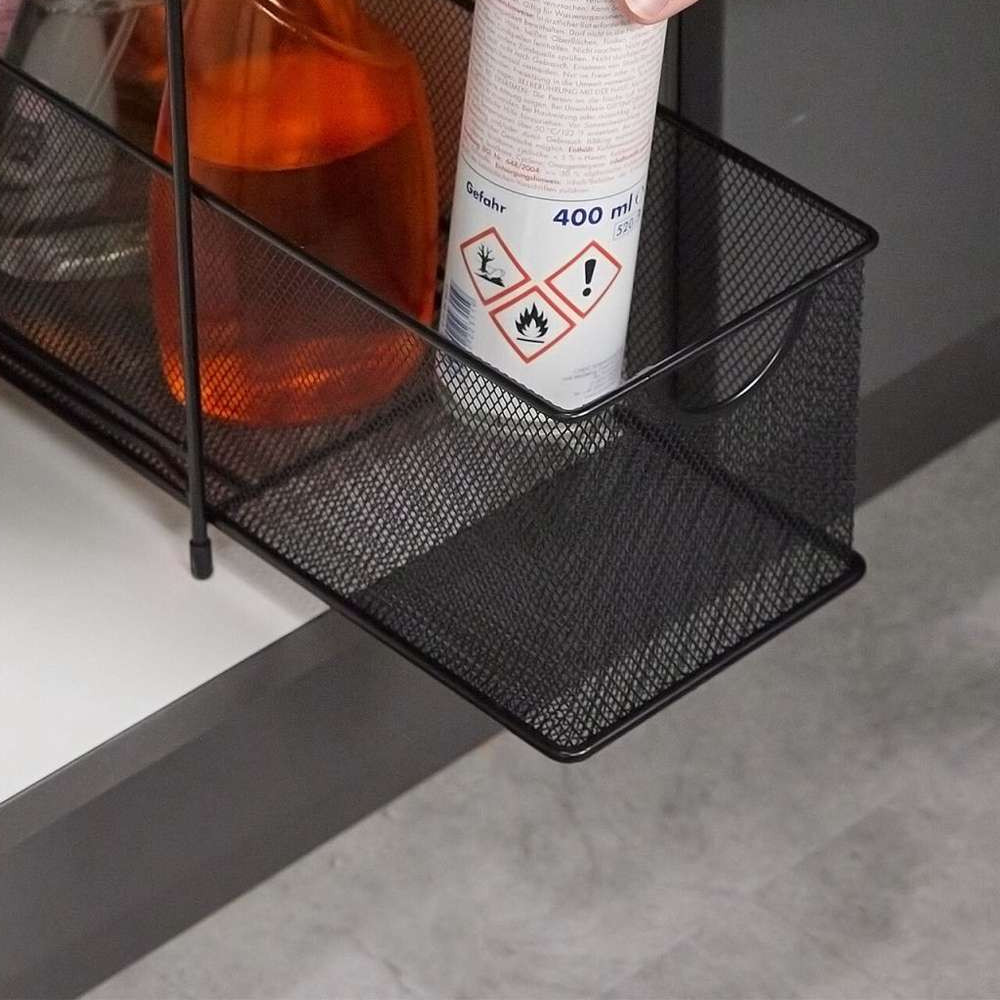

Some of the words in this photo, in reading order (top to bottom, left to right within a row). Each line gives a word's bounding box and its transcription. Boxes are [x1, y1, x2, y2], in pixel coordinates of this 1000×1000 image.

[466, 181, 507, 213] Gefahr
[553, 207, 603, 227] 400
[611, 193, 633, 220] ml
